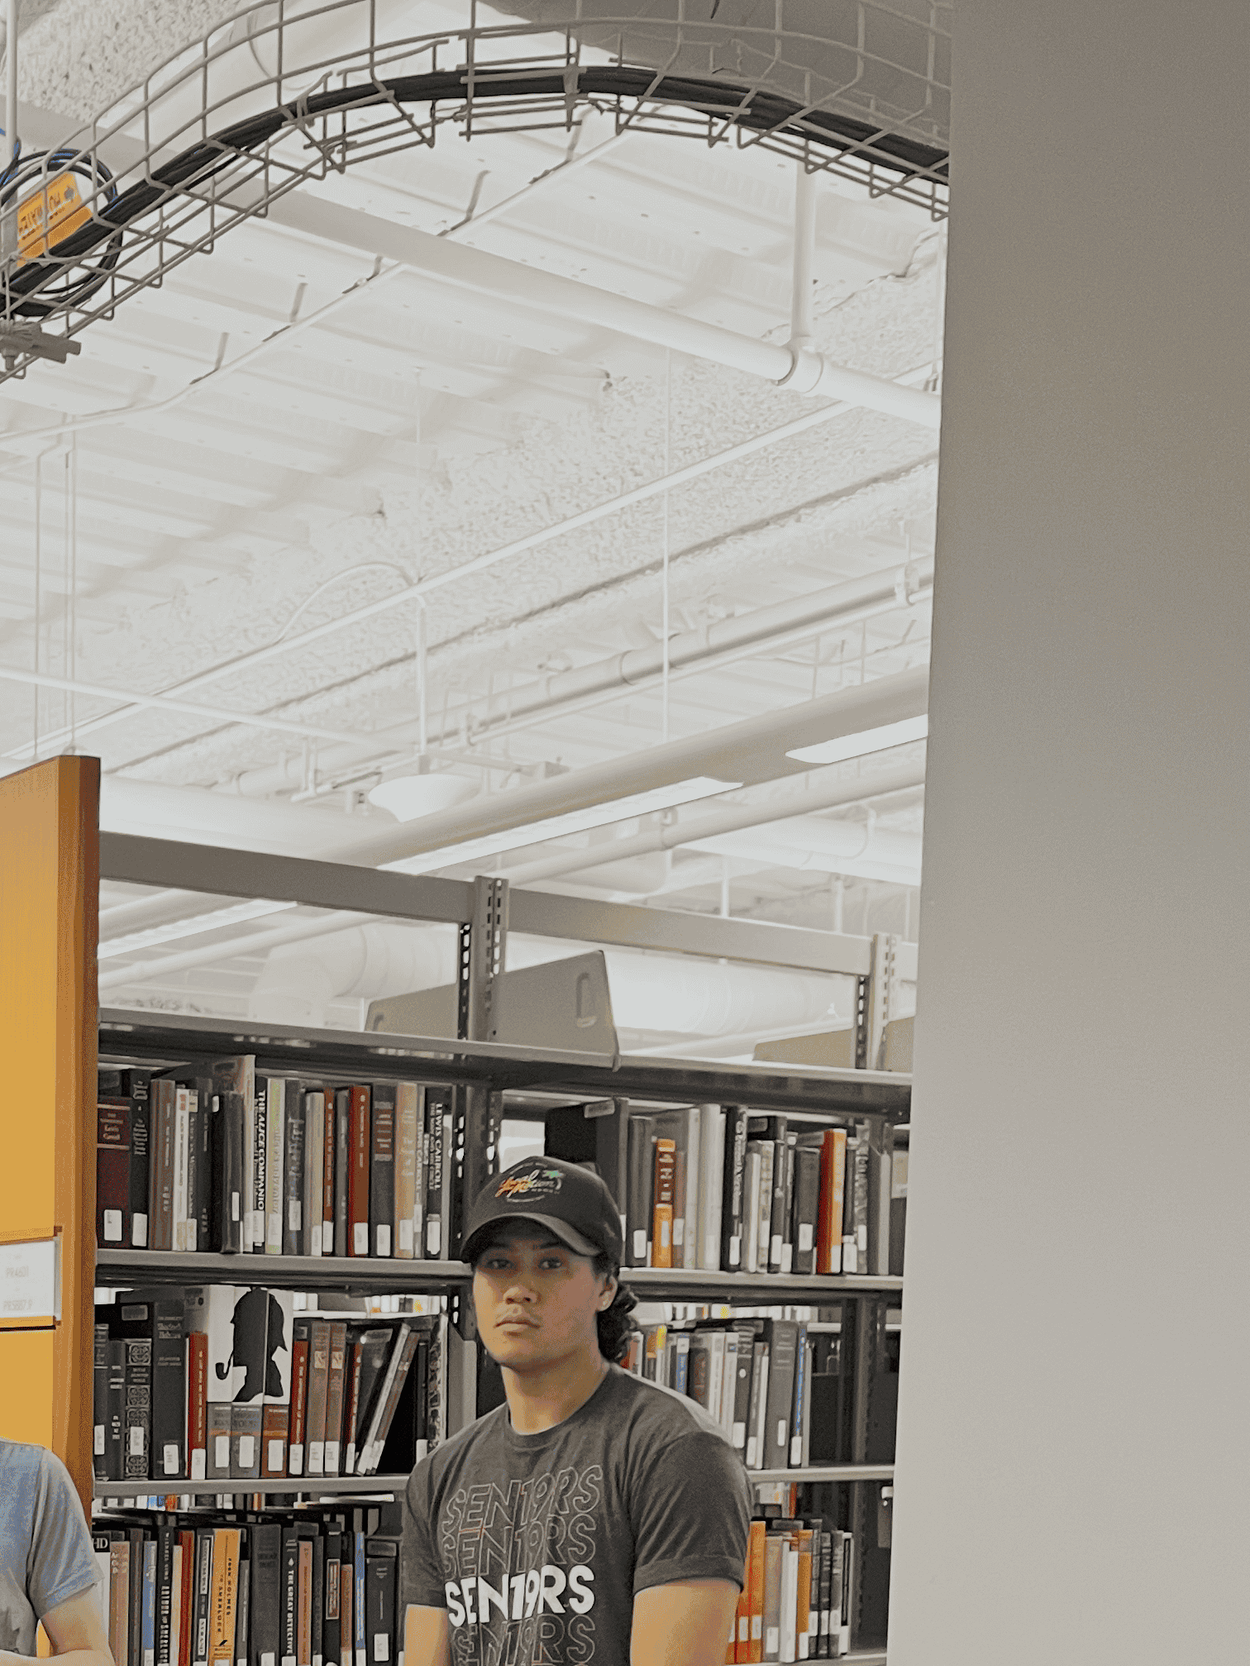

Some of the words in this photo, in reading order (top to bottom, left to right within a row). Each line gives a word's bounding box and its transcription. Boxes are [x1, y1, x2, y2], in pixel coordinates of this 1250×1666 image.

[258, 1089, 266, 1113] THE
[258, 1114, 266, 1148] ALICE
[435, 1102, 443, 1137] LEWIS
[257, 1148, 266, 1211] COMPANIO
[434, 1138, 443, 1191] CARROLL
[286, 1570, 295, 1585] THE
[286, 1586, 294, 1612] GREAT
[444, 1564, 596, 1628] SEN19RS
[285, 1612, 294, 1655] DETECTIVE
